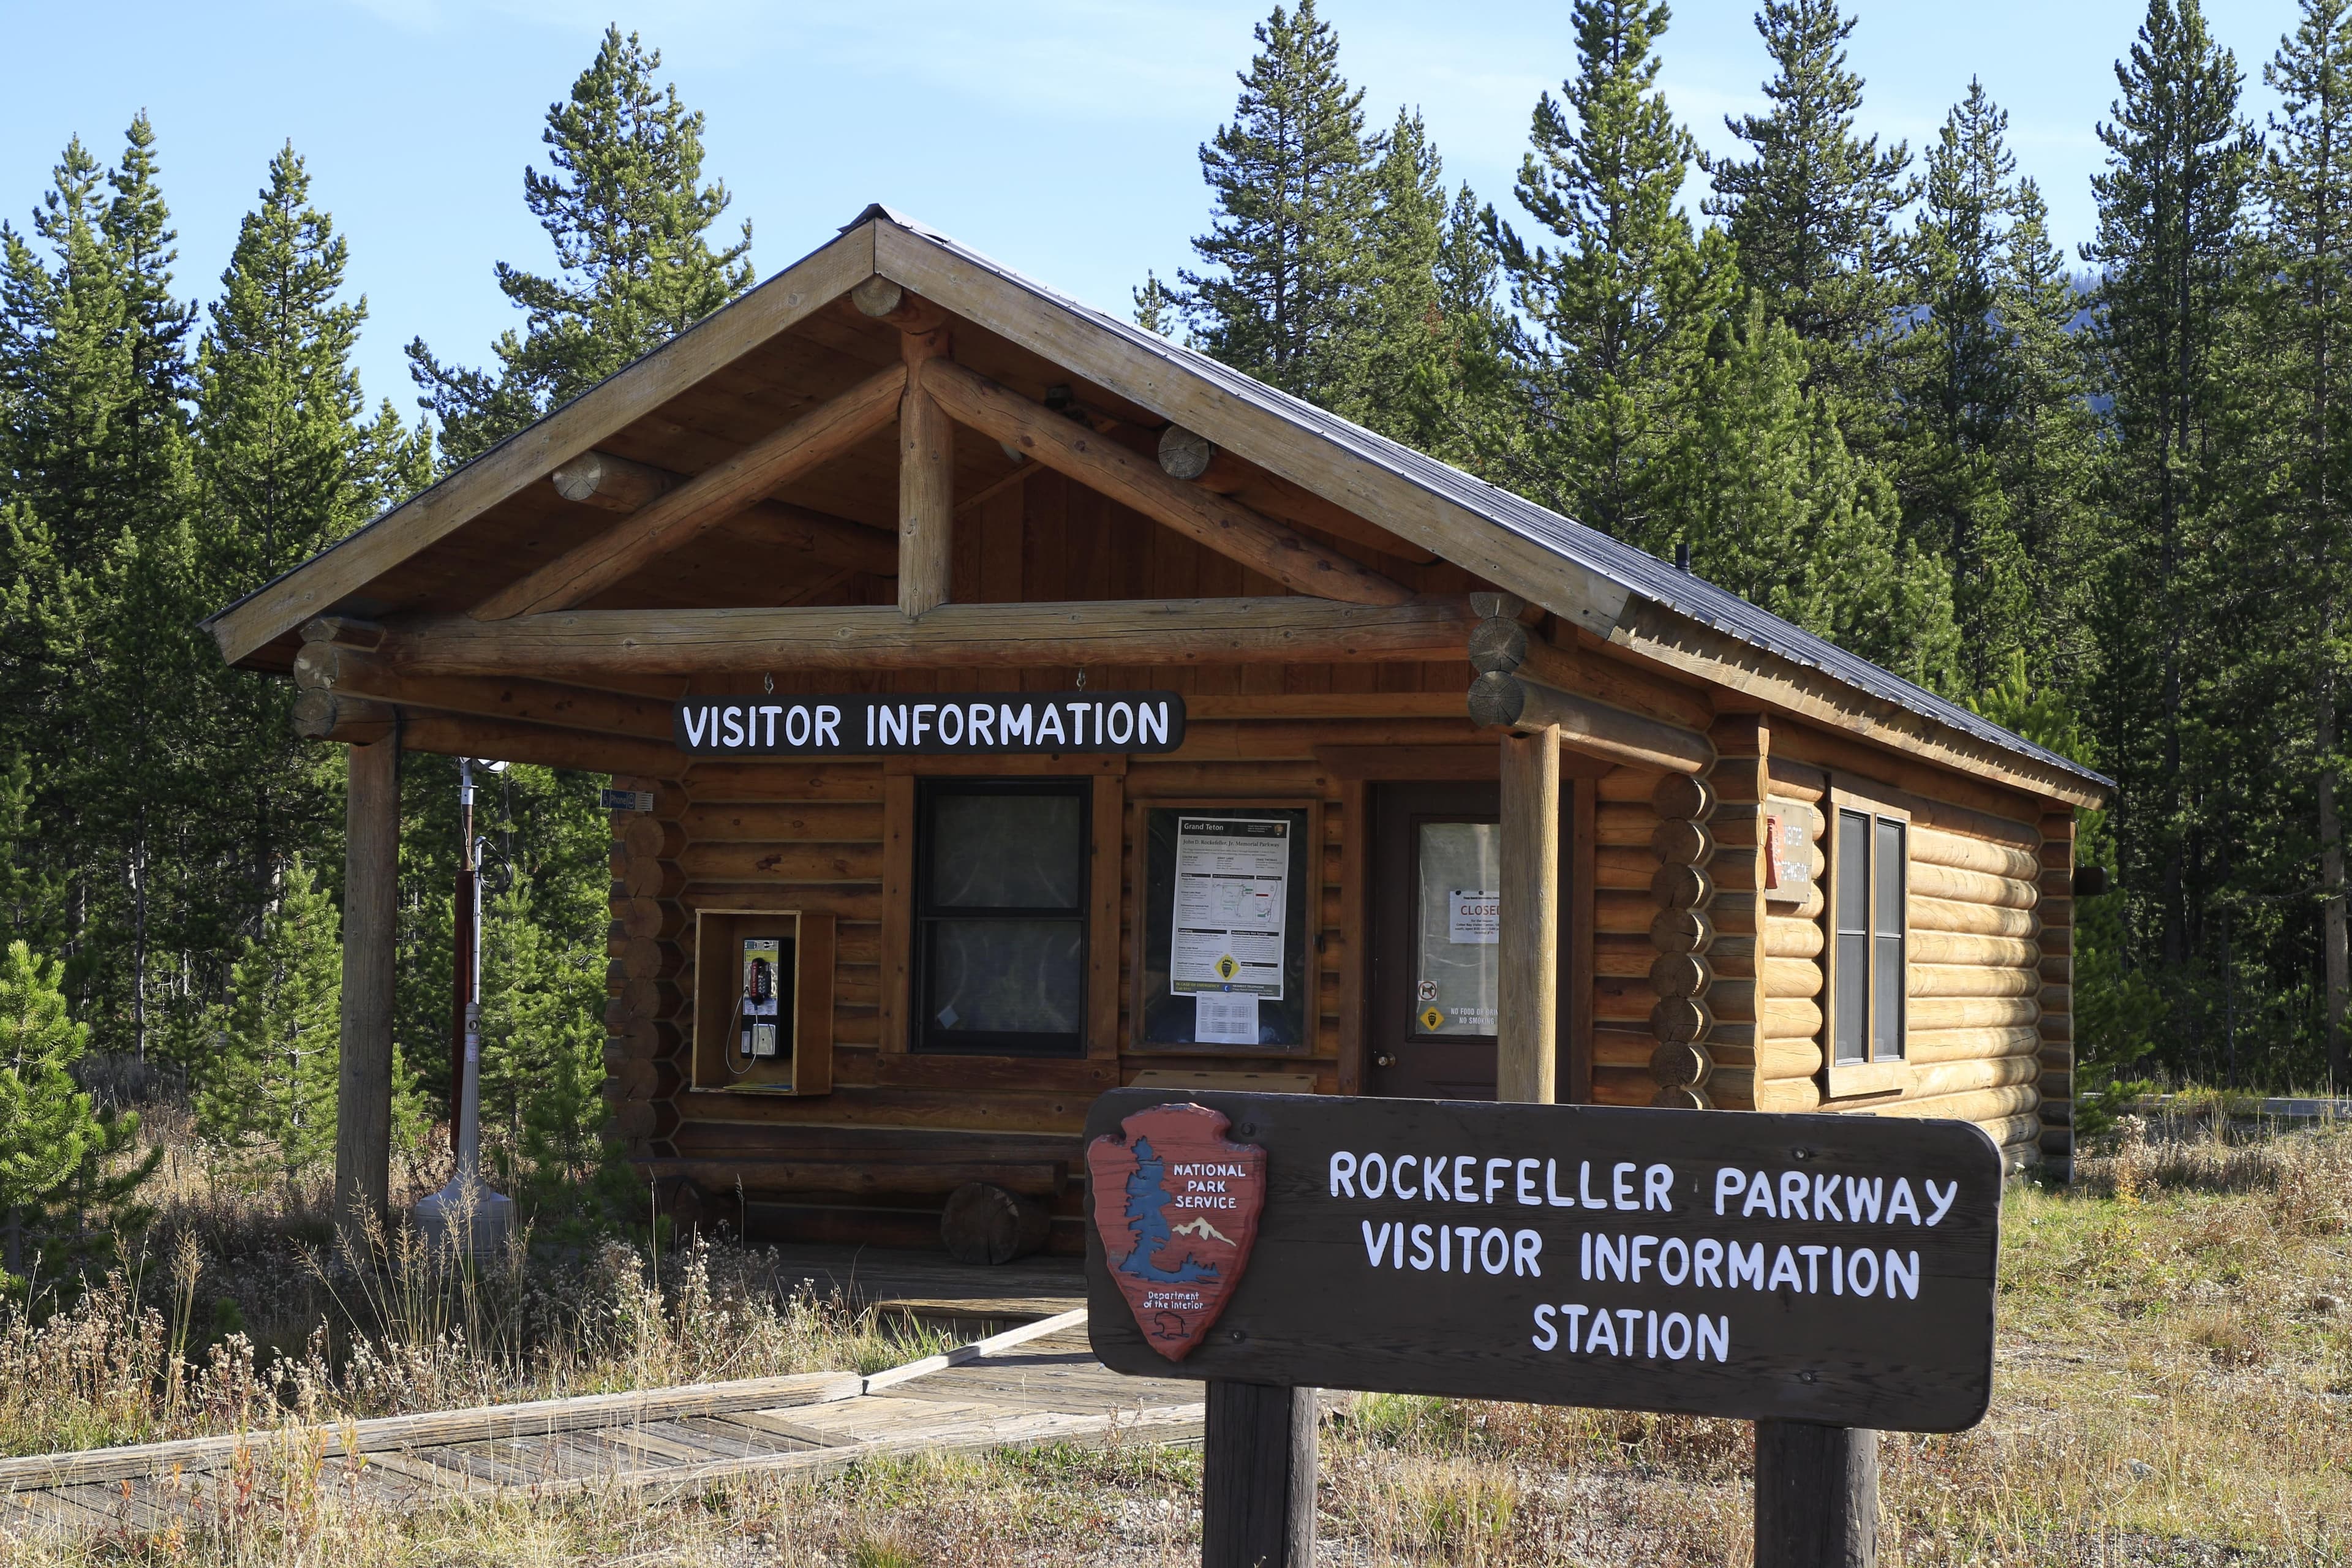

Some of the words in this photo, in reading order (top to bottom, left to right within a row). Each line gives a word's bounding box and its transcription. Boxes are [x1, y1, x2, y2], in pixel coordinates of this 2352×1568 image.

[683, 705, 841, 747] VISITOR
[867, 701, 1168, 746] INFORMATION
[611, 794, 627, 804] Phone
[1174, 1164, 1246, 1177] NATIONAL
[1188, 1180, 1226, 1193] PARK
[1330, 1151, 1674, 1212] ROCKEFELLER
[1715, 1167, 1958, 1226] PARKWAY
[1175, 1195, 1237, 1209] SERVICE
[1362, 1220, 1542, 1277] VISITOR
[1581, 1232, 1920, 1300] INFORMATION
[1148, 1291, 1199, 1300] Department
[1144, 1300, 1152, 1308] of
[1155, 1300, 1168, 1309] the
[1171, 1300, 1204, 1310] Interior
[1532, 1303, 1729, 1363] STATION
